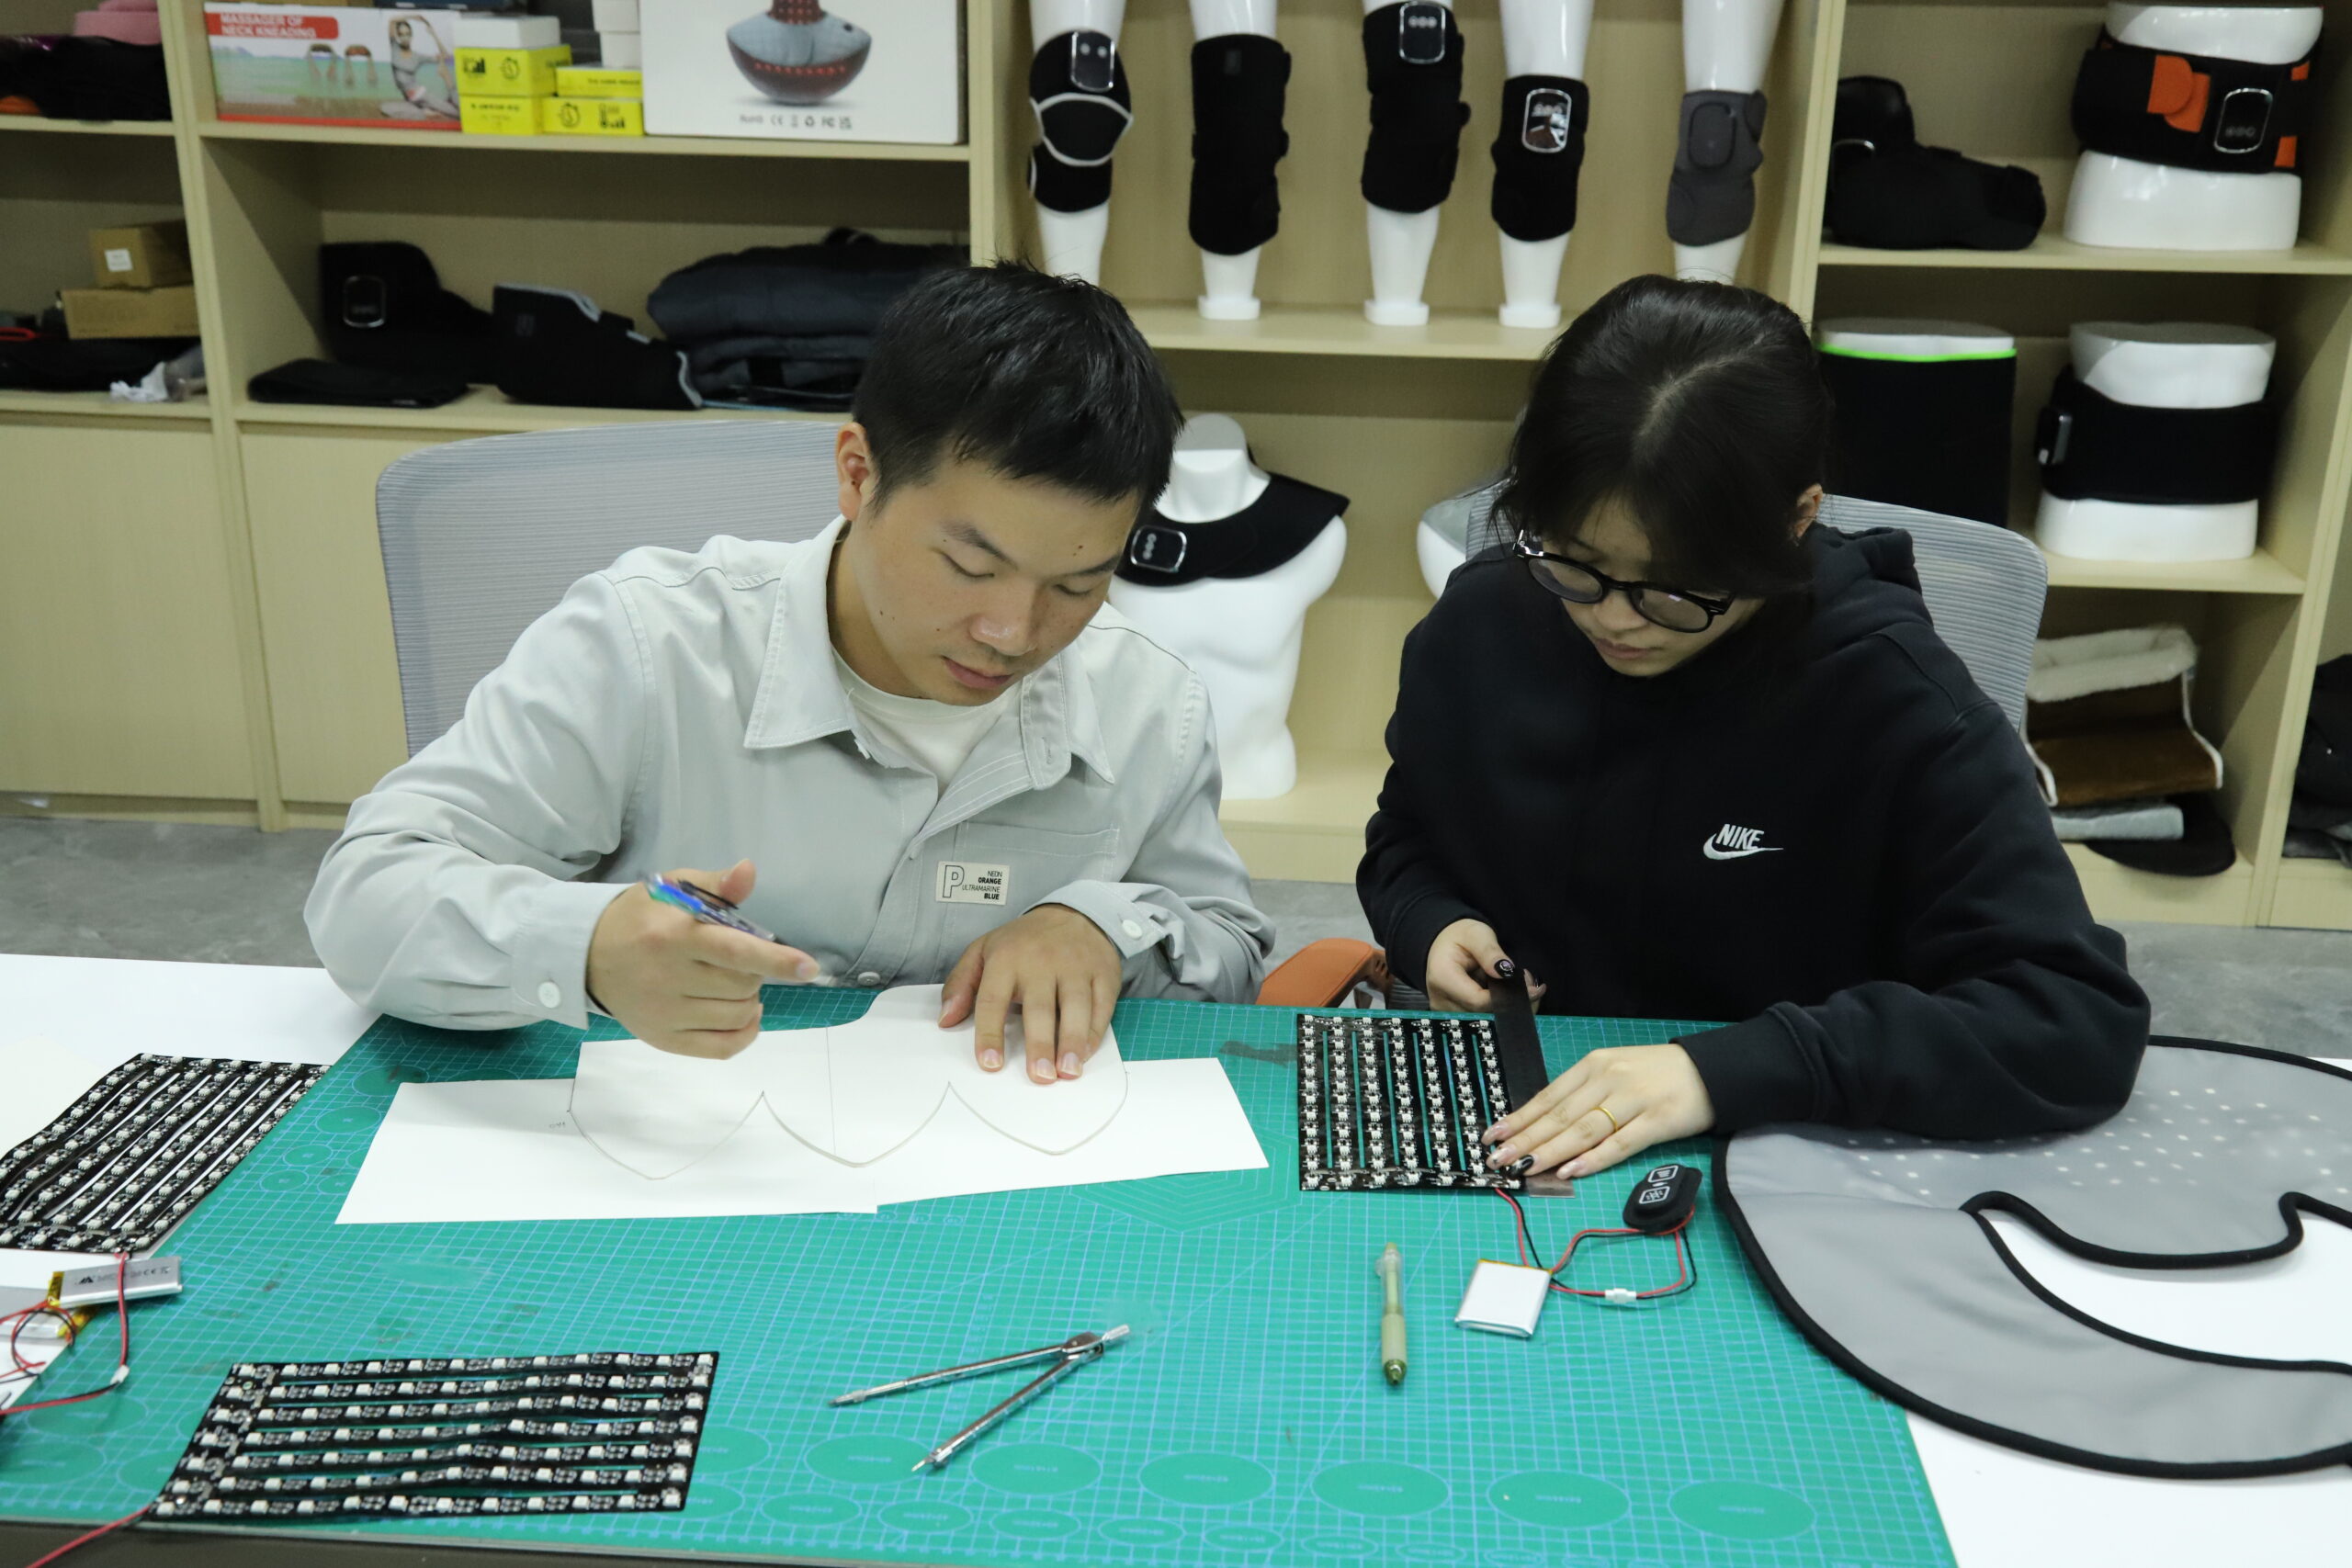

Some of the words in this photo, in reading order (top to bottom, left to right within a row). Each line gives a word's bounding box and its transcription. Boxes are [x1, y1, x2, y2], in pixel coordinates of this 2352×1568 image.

[220, 13, 285, 26] MASSAGER
[287, 16, 304, 27] OF
[221, 26, 254, 37] NECK
[255, 27, 316, 39] KNEADING
[1715, 823, 1765, 851] NIKE
[943, 864, 966, 898] P
[962, 885, 1001, 893] ULTRAMARINE
